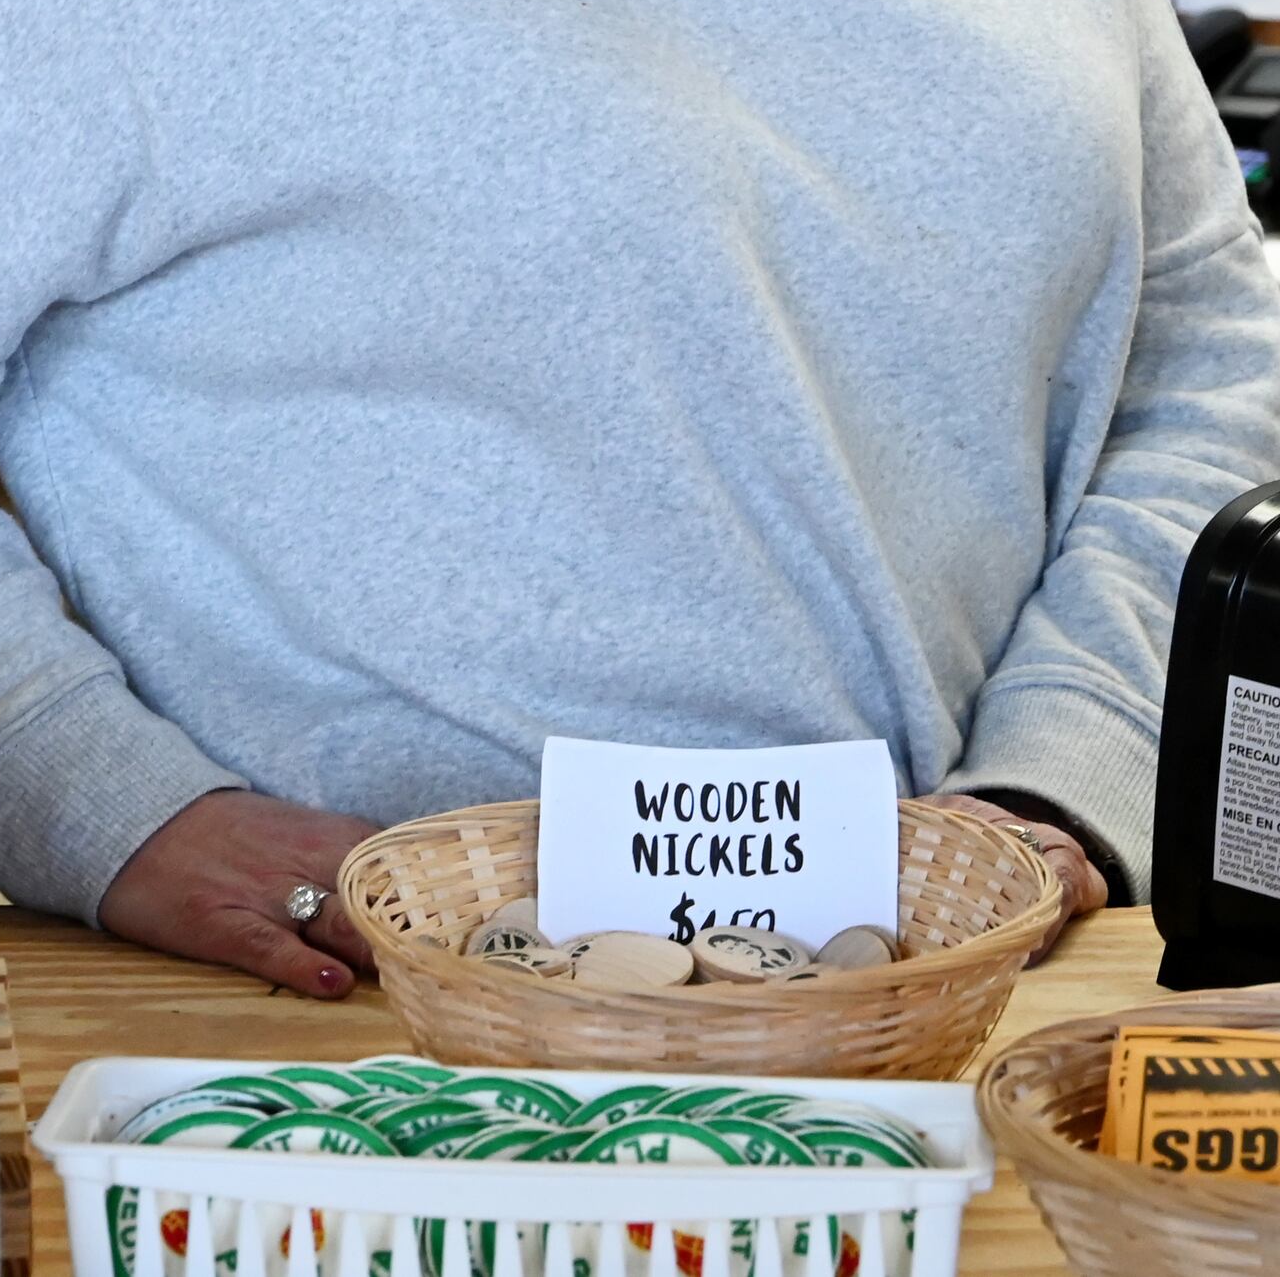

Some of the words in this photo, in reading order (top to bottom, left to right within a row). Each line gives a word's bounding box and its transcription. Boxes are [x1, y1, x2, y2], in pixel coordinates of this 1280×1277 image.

[1233, 700, 1250, 714] High
[1230, 729, 1243, 740] and
[1246, 735, 1265, 747] away
[1225, 784, 1236, 794] del
[1262, 794, 1273, 804] del
[1233, 779, 1244, 789] por
[634, 779, 801, 823] WOODEN
[1223, 807, 1253, 825] MISE
[1257, 816, 1273, 831] EN
[632, 832, 805, 877] NICKELS
[668, 891, 777, 946] $150
